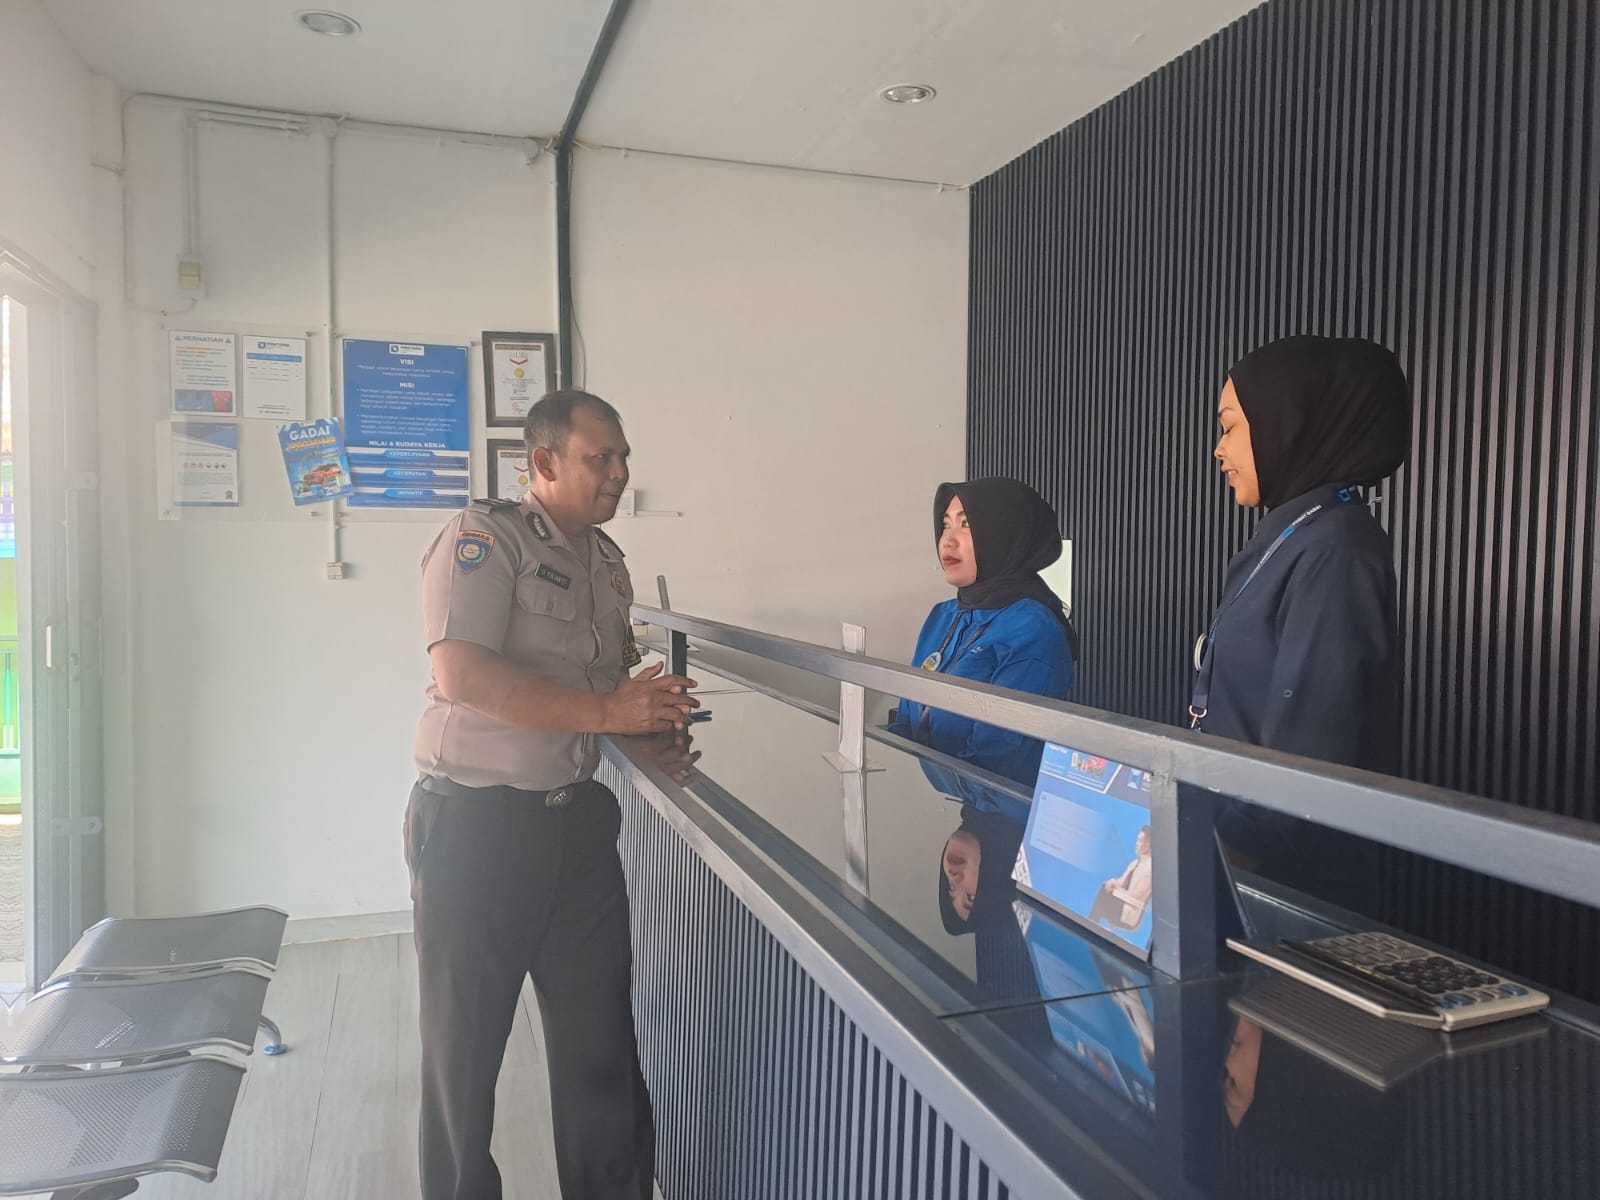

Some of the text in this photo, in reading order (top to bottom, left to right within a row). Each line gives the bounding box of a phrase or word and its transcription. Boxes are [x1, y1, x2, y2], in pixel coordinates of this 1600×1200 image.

[289, 425, 330, 441] GADAI
[368, 439, 388, 447] NILAI
[395, 440, 423, 448] BUDAYA
[424, 441, 447, 449] KERJA
